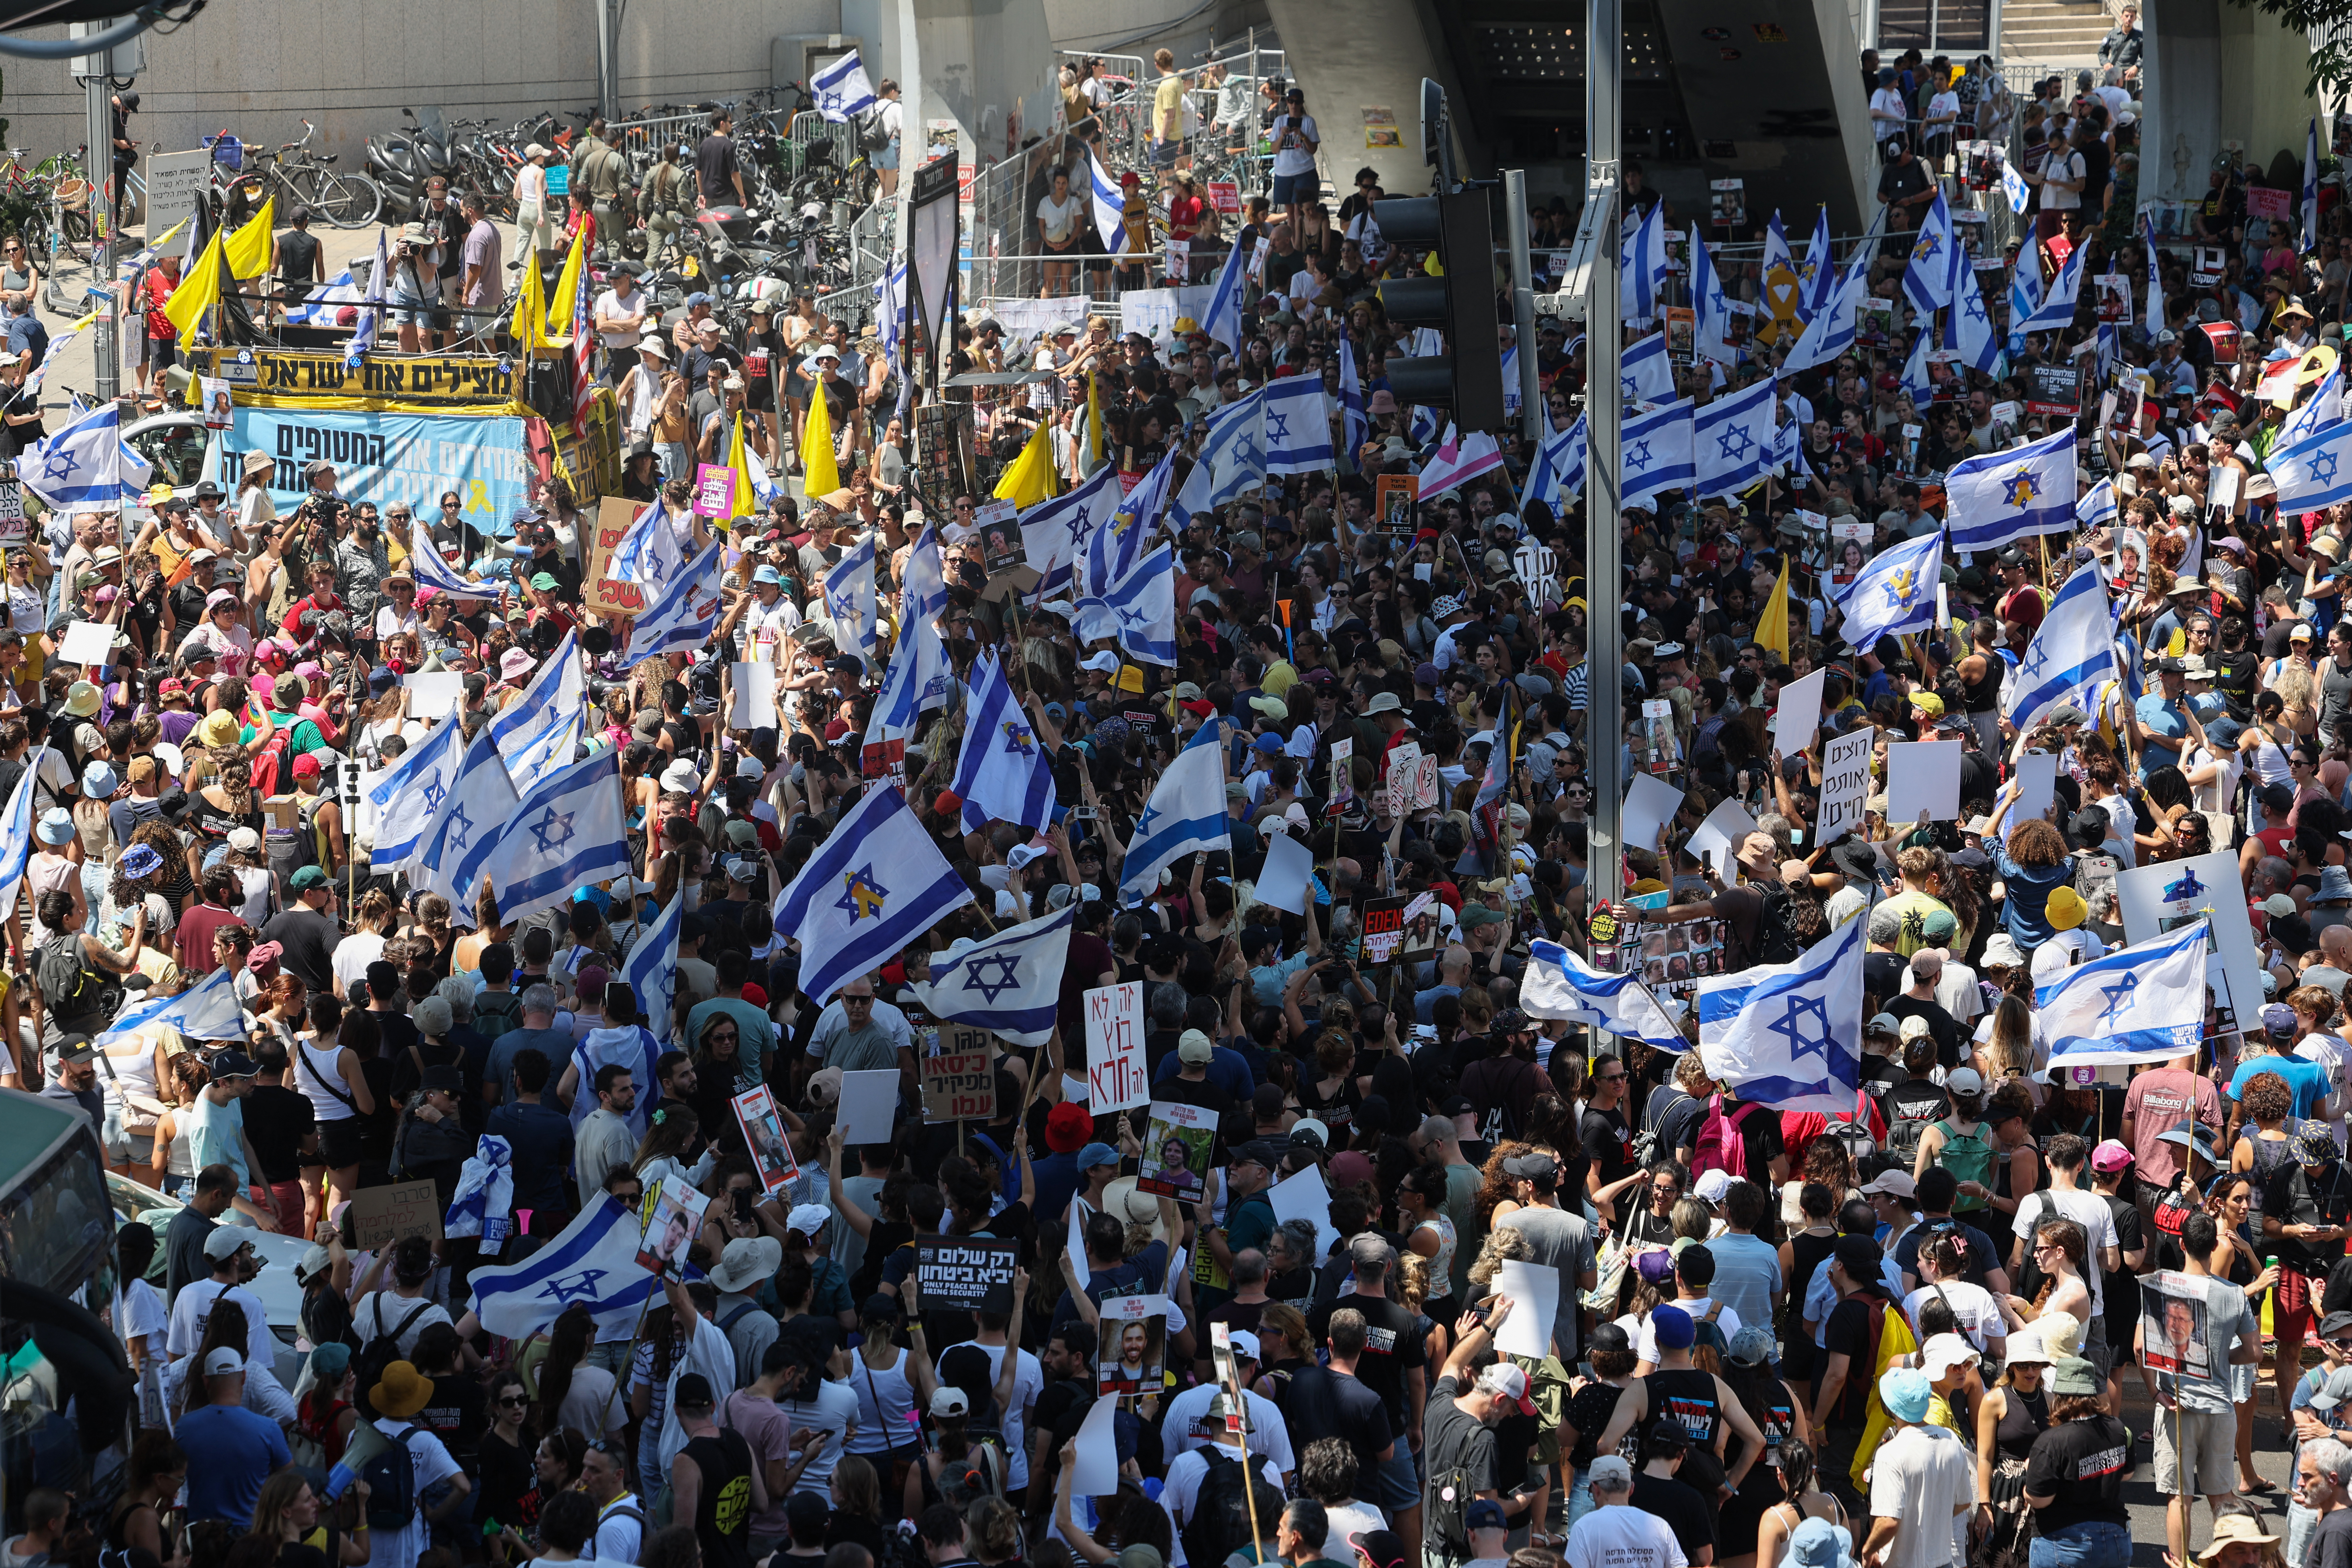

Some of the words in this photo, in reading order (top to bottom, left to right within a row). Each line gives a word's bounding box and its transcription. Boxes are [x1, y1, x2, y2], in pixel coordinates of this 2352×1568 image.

[2250, 189, 2289, 200] HOSTAGE
[2258, 196, 2280, 206] DEAL
[2193, 245, 2225, 272] כן
[261, 354, 354, 389] ישראל
[363, 363, 404, 391] את
[411, 360, 511, 394] מצילים
[2050, 368, 2076, 378] במלחמה
[2050, 376, 2076, 386] מפסידים
[277, 424, 385, 467] החטופים
[393, 437, 431, 472] את
[1118, 473, 1140, 483] OSTAGE
[704, 483, 727, 491] מצילים
[702, 499, 724, 508] חיים
[982, 504, 998, 515] מרציאנו
[998, 502, 1008, 511] נועה
[993, 512, 1002, 521] (19)
[997, 558, 1006, 566] בעזה
[1006, 556, 1015, 564] נרצחה
[1123, 711, 1156, 723] העוטף
[1832, 738, 1867, 765] רוצים
[1825, 767, 1865, 794] אותם
[1823, 795, 1863, 829] חיים!
[1365, 908, 1403, 934] EDEN
[1591, 921, 1616, 935] אשם
[1367, 933, 1399, 947] סליחה
[1593, 930, 1610, 938] במחדל
[1372, 948, 1390, 962] עדן
[1118, 985, 1134, 1012] זה
[1092, 990, 1109, 1022] לא
[2171, 1025, 2198, 1036] ופשי
[954, 1030, 987, 1055] מגן
[1103, 1016, 1134, 1060] בוץ
[2172, 1034, 2197, 1045] ארצנו
[924, 1054, 986, 1074] כיסאו
[929, 1073, 992, 1094] מפקיר
[1090, 1056, 1130, 1108] חרא
[1132, 1066, 1144, 1094] זה
[1874, 1080, 1892, 1089] MISSING
[952, 1095, 992, 1116] עמו
[2143, 1094, 2182, 1109] Billabong
[1179, 1112, 1197, 1121] KALDERON
[1142, 1159, 1162, 1171] BRING
[1140, 1168, 1153, 1178] HIM
[391, 1186, 430, 1203] סרבו
[354, 1205, 415, 1230] למלחמה!
[368, 1228, 394, 1243] עכשיו!
[403, 1224, 431, 1236] עסקה
[937, 1247, 987, 1265] שלום
[990, 1251, 1015, 1269] רק
[917, 1265, 974, 1282] ביטחון
[977, 1268, 1014, 1284] יביא
[949, 1290, 986, 1298] SECURITY
[1371, 1327, 1397, 1340] MISSING
[1366, 1335, 1393, 1352] FORUM
[2147, 1352, 2164, 1365] HOME
[1100, 1361, 1119, 1372] BRING
[1100, 1372, 1111, 1382] HIM
[2079, 1454, 2099, 1468] HOSTAGES
[2099, 1451, 2108, 1460] AND
[2108, 1445, 2127, 1457] MISSING
[2079, 1460, 2106, 1476] FAMILIES
[2107, 1454, 2126, 1469] FORUM
[1605, 1548, 1625, 1556] חדשה
[1627, 1547, 1654, 1555] ממשלה
[1606, 1557, 1625, 1565] השנה
[1638, 1556, 1654, 1564] לפני
